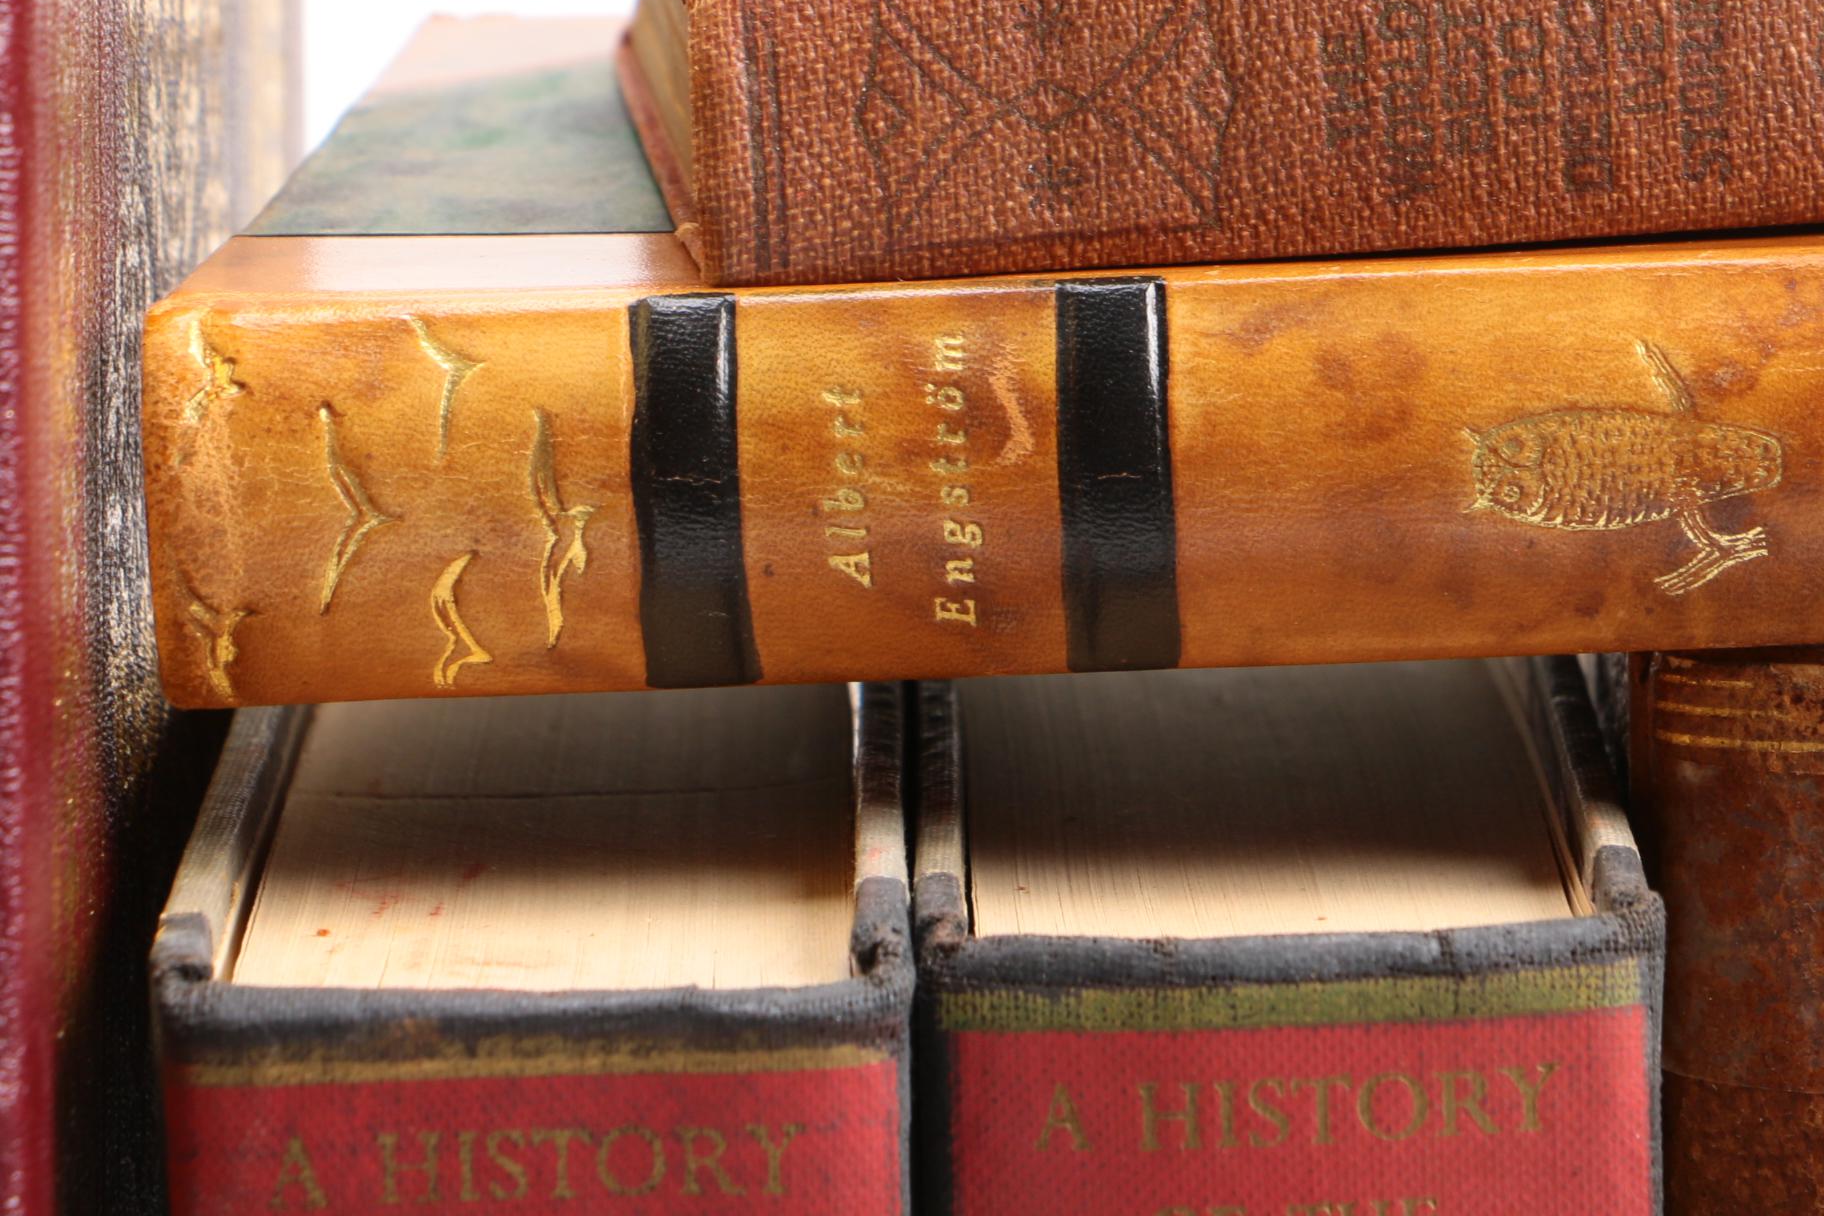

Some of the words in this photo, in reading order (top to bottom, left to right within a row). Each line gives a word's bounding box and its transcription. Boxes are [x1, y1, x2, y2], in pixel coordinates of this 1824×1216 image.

[820, 383, 874, 589] Albert
[924, 329, 985, 628] Engström
[268, 1135, 329, 1212] A
[375, 1121, 807, 1206] HISTORY
[1033, 1082, 1094, 1153] A
[1136, 1060, 1562, 1153] HISTORY
